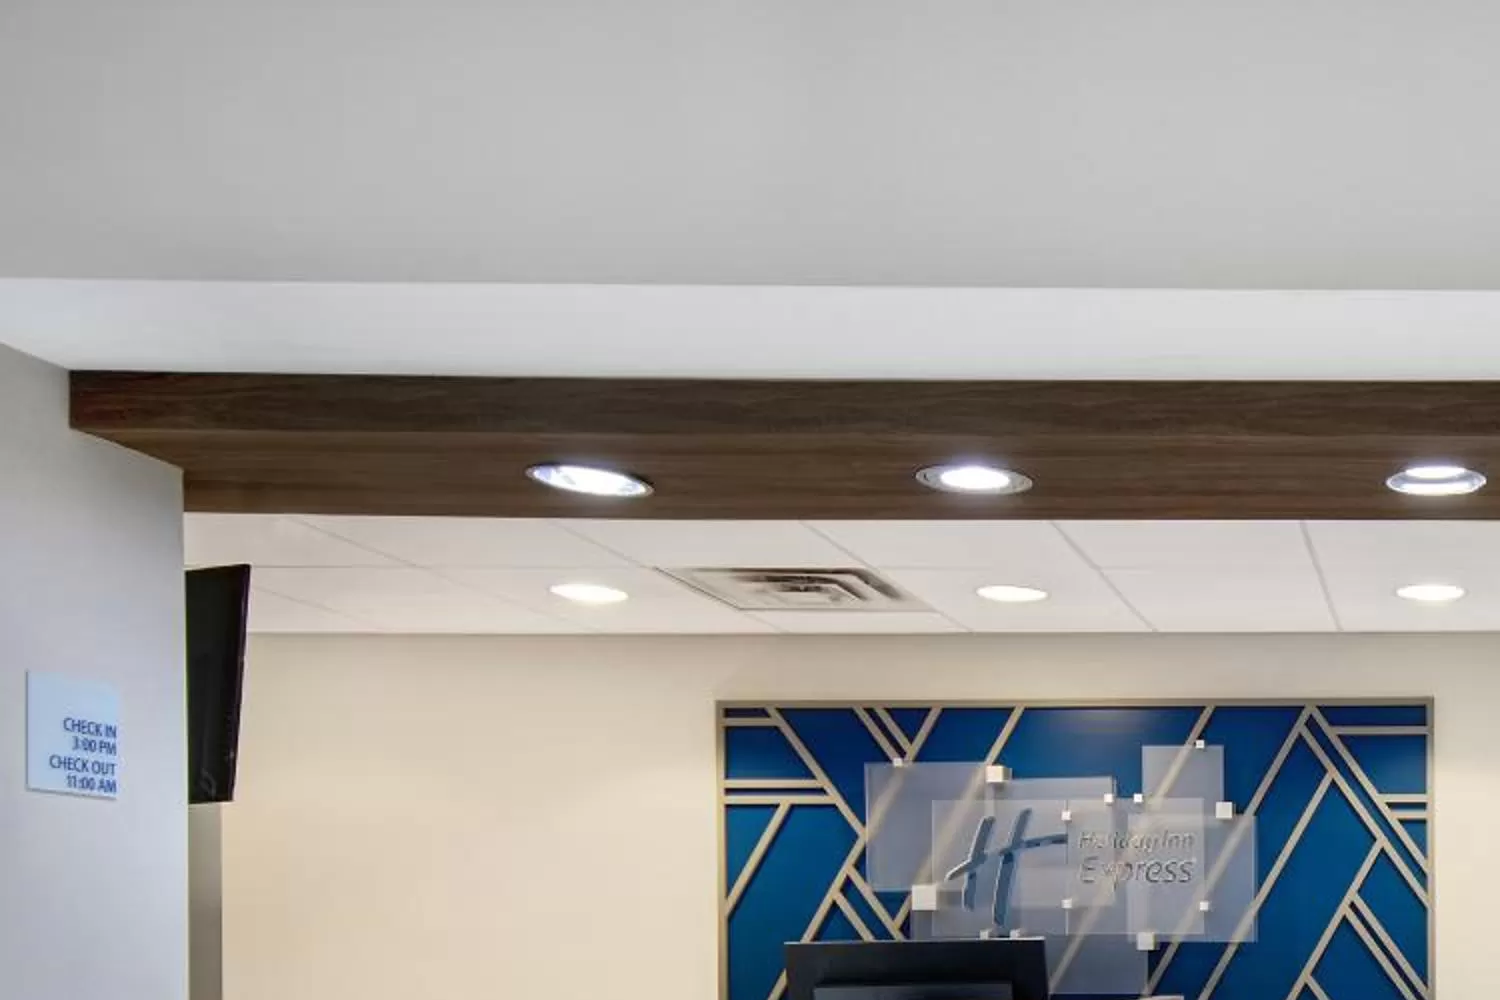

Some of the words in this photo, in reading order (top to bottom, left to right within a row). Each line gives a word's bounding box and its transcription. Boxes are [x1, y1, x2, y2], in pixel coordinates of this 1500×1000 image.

[63, 717, 103, 737] CHECK
[105, 724, 117, 739] IN
[99, 740, 117, 757] PM
[49, 754, 89, 773] CHECK
[91, 760, 118, 777] OUT
[67, 774, 97, 791] 11:00
[98, 778, 117, 793] AM
[1161, 829, 1195, 849] Inn
[1080, 856, 1194, 892] Express
